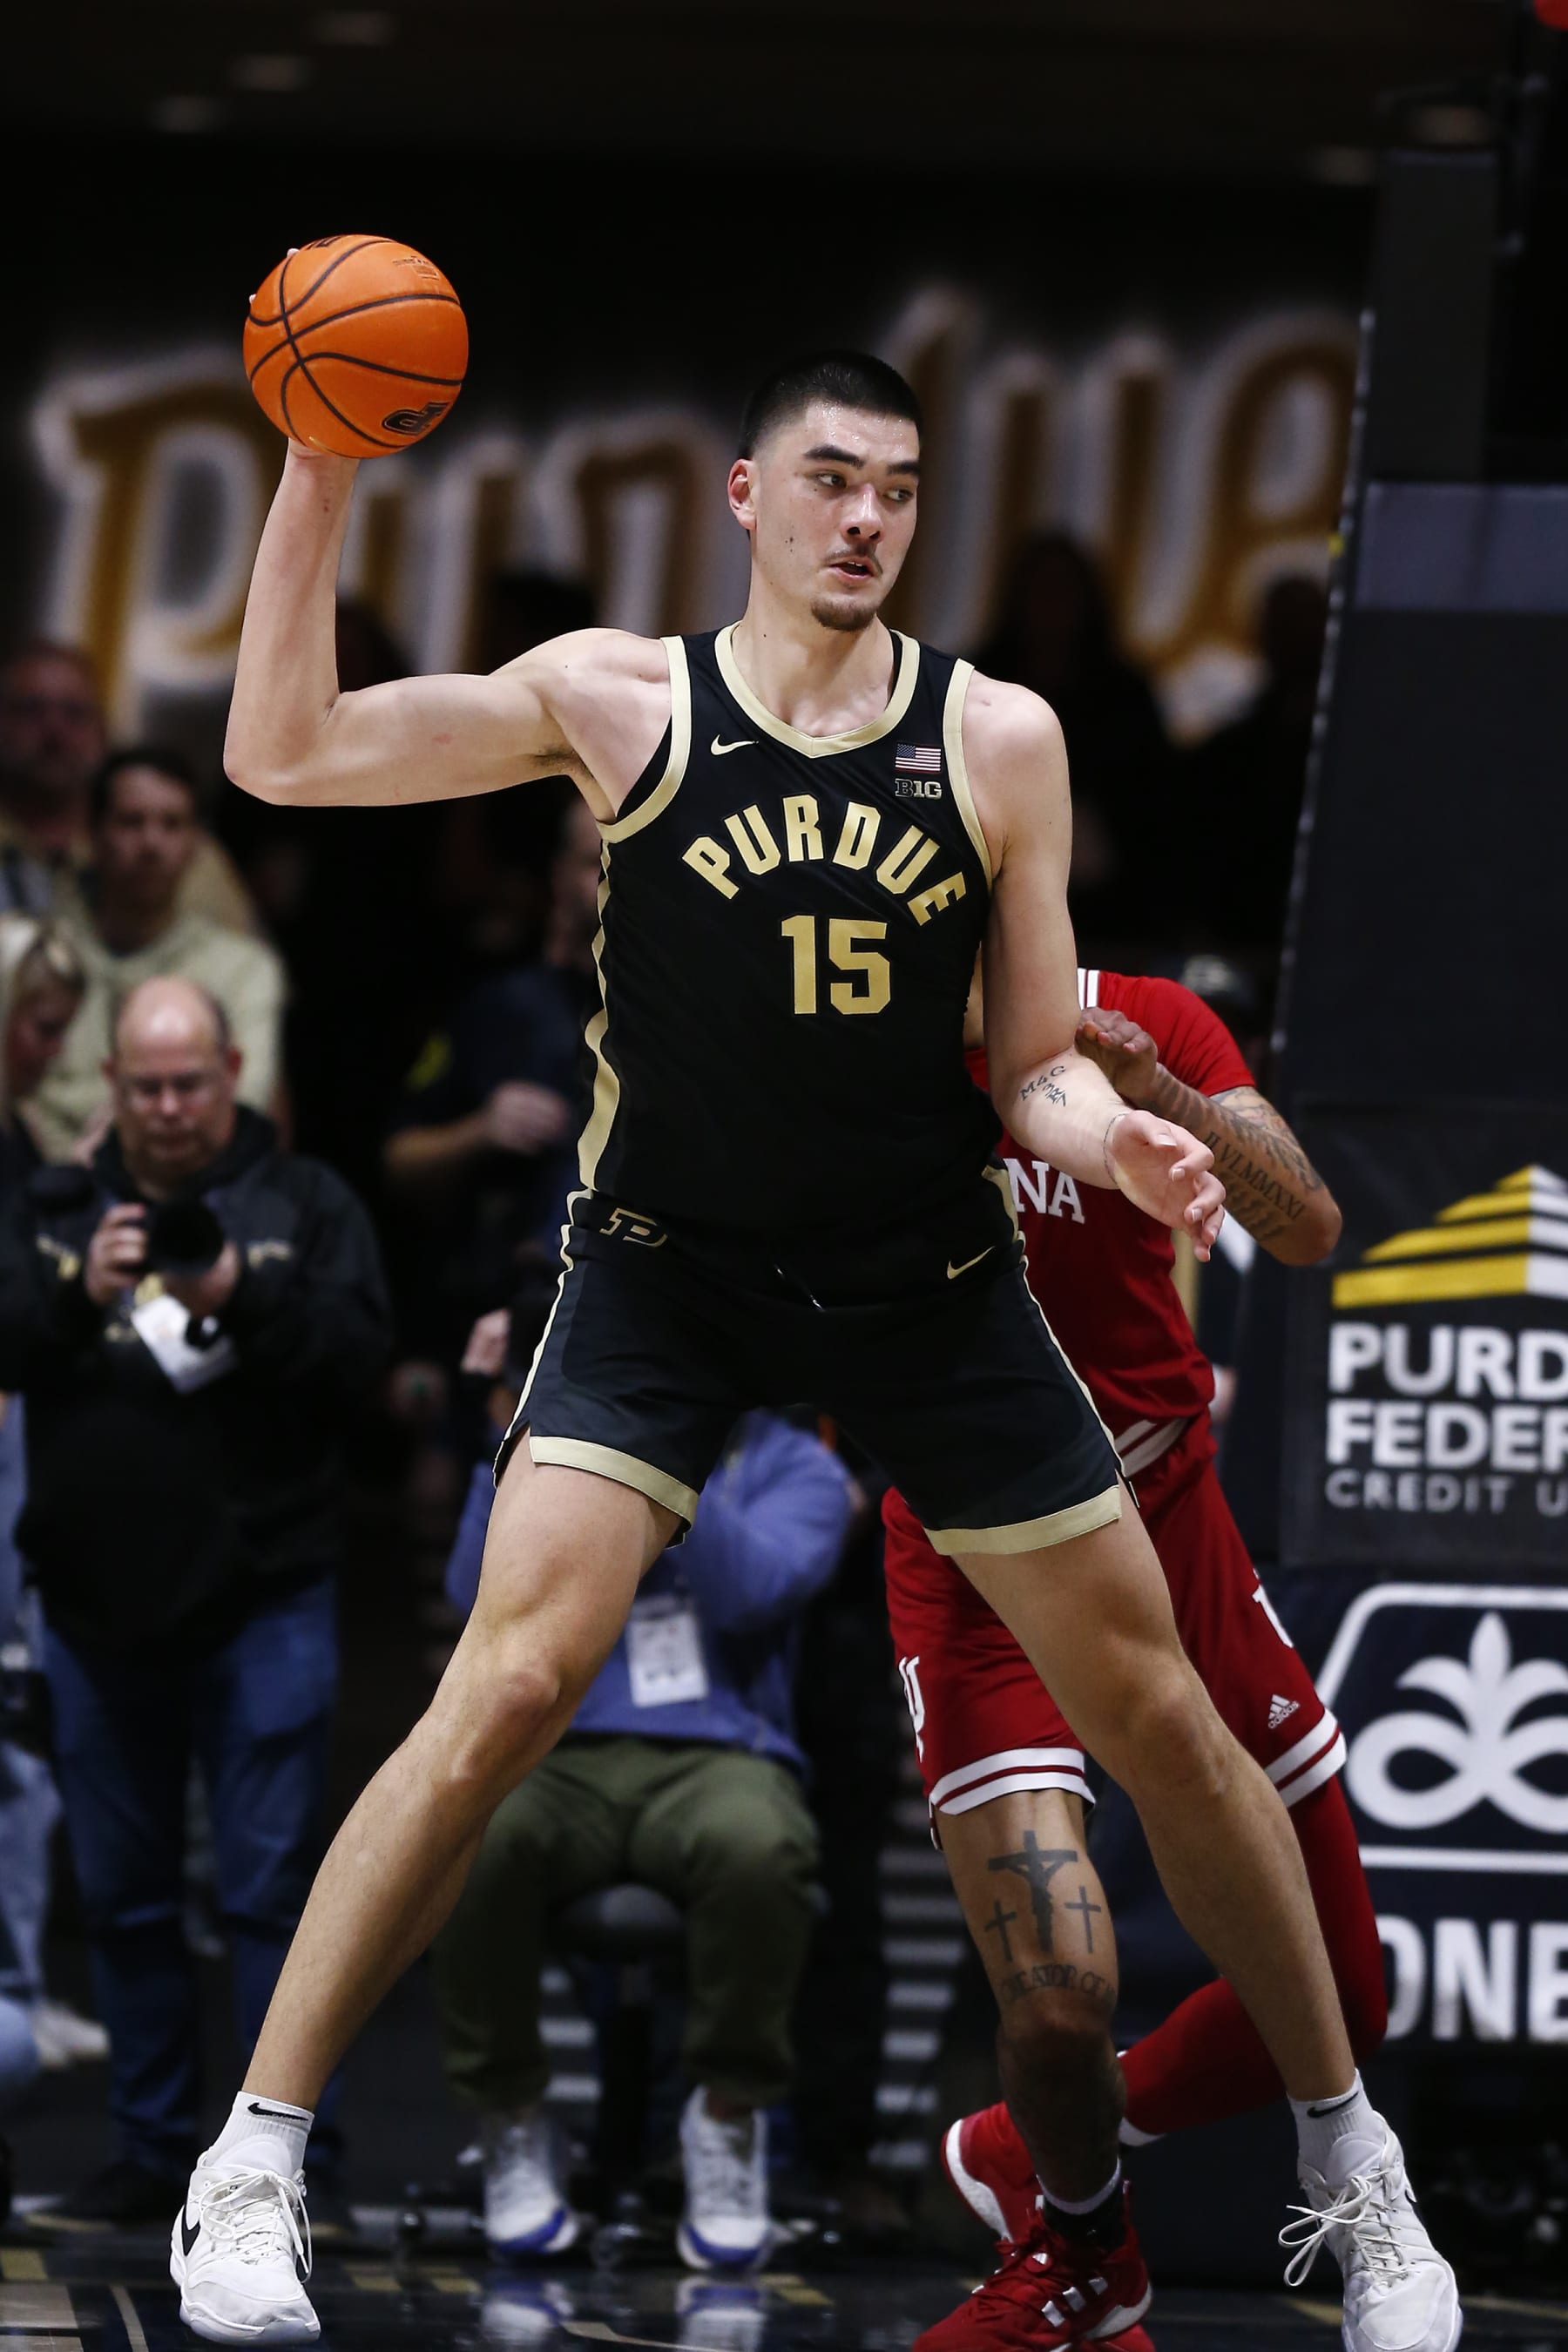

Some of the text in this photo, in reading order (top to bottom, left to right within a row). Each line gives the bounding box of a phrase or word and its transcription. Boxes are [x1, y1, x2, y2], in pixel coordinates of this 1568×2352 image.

[682, 794, 967, 926] PURDUE
[781, 915, 891, 1015] 15
[1329, 1322, 1568, 1401] PURD
[1325, 1470, 1512, 1514] CREDIT
